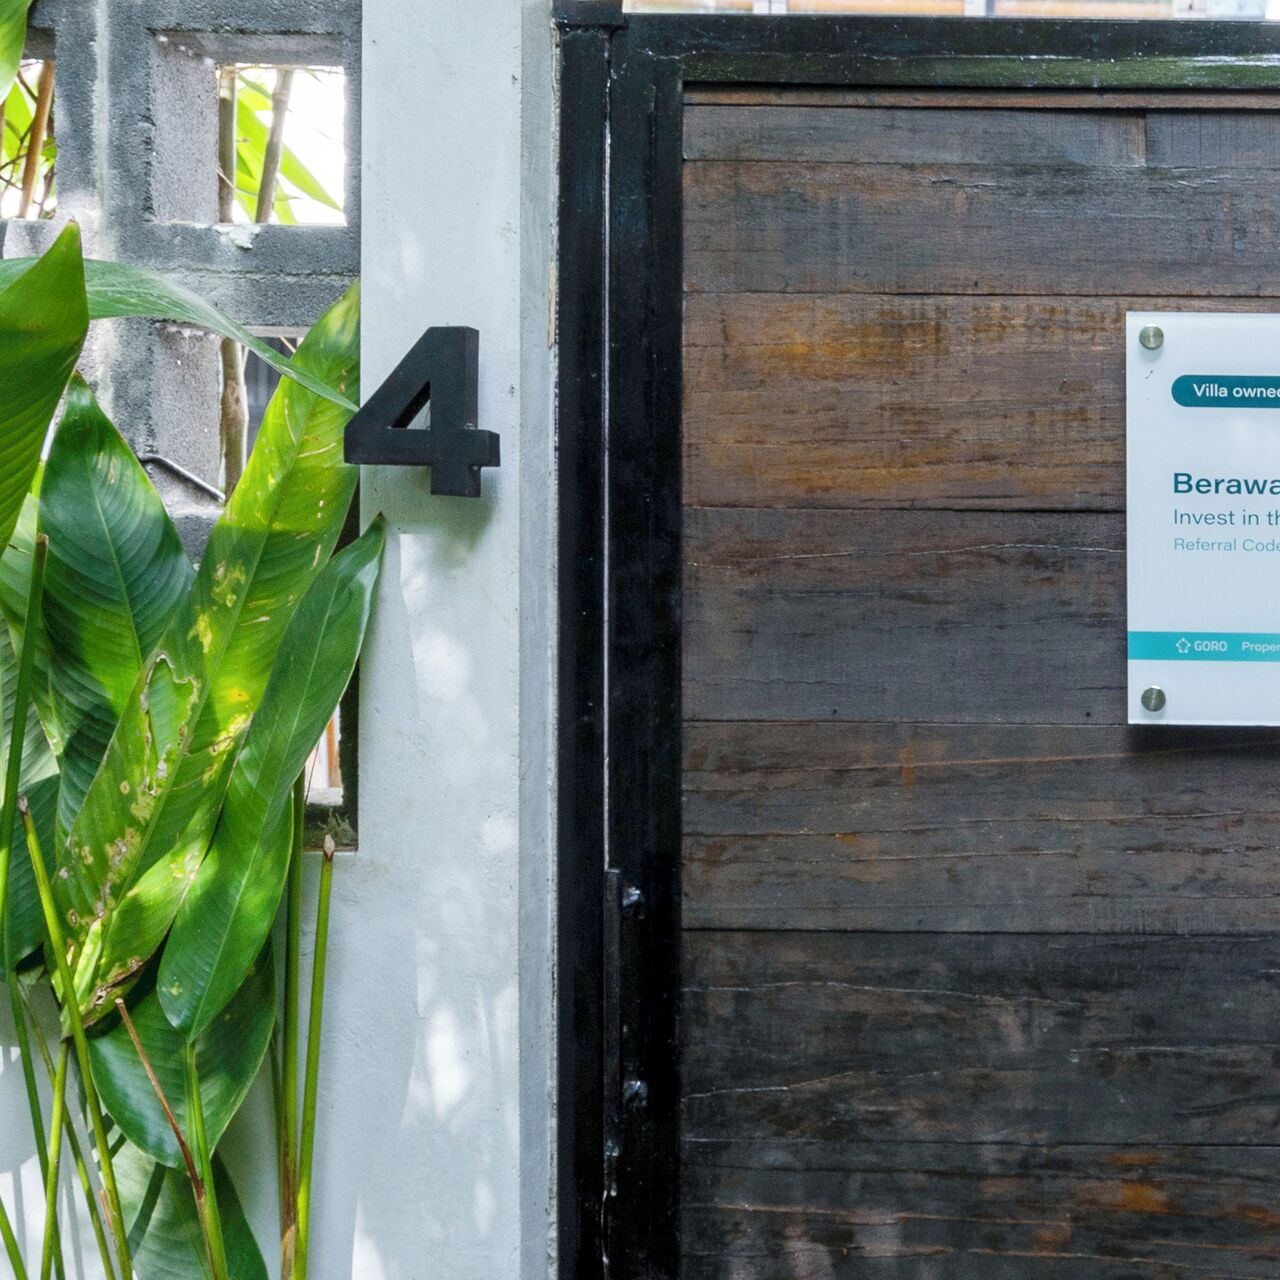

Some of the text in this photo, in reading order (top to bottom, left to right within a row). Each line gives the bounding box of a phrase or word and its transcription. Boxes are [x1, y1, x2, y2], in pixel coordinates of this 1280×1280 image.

[1192, 383, 1228, 397] Villa
[344, 326, 500, 497] 4
[1174, 509, 1235, 526] Invest
[1242, 509, 1260, 526] in
[1174, 537, 1237, 552] Referral
[1194, 640, 1228, 652] GORO
